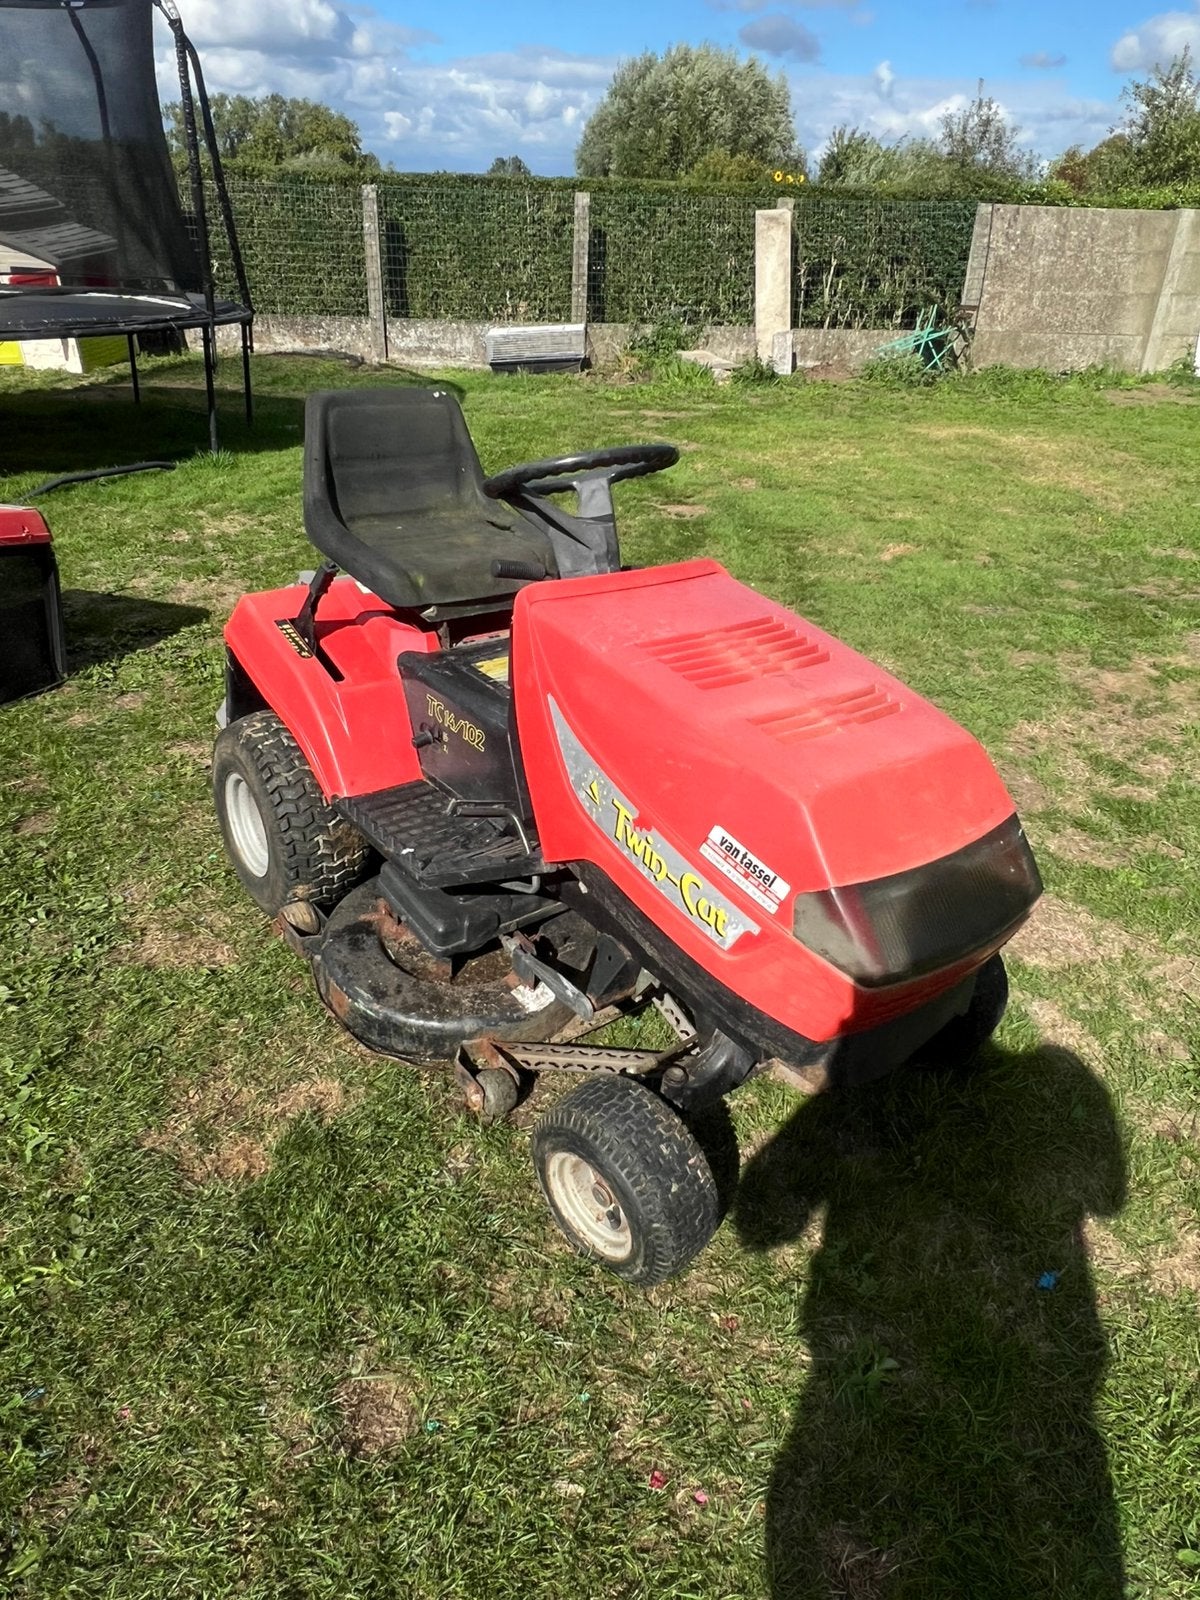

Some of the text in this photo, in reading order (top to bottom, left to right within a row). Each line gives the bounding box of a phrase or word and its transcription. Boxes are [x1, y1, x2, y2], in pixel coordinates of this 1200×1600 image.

[612, 799, 728, 938] Twin-Cut
[719, 836, 740, 859] van
[739, 852, 777, 888] tassel
